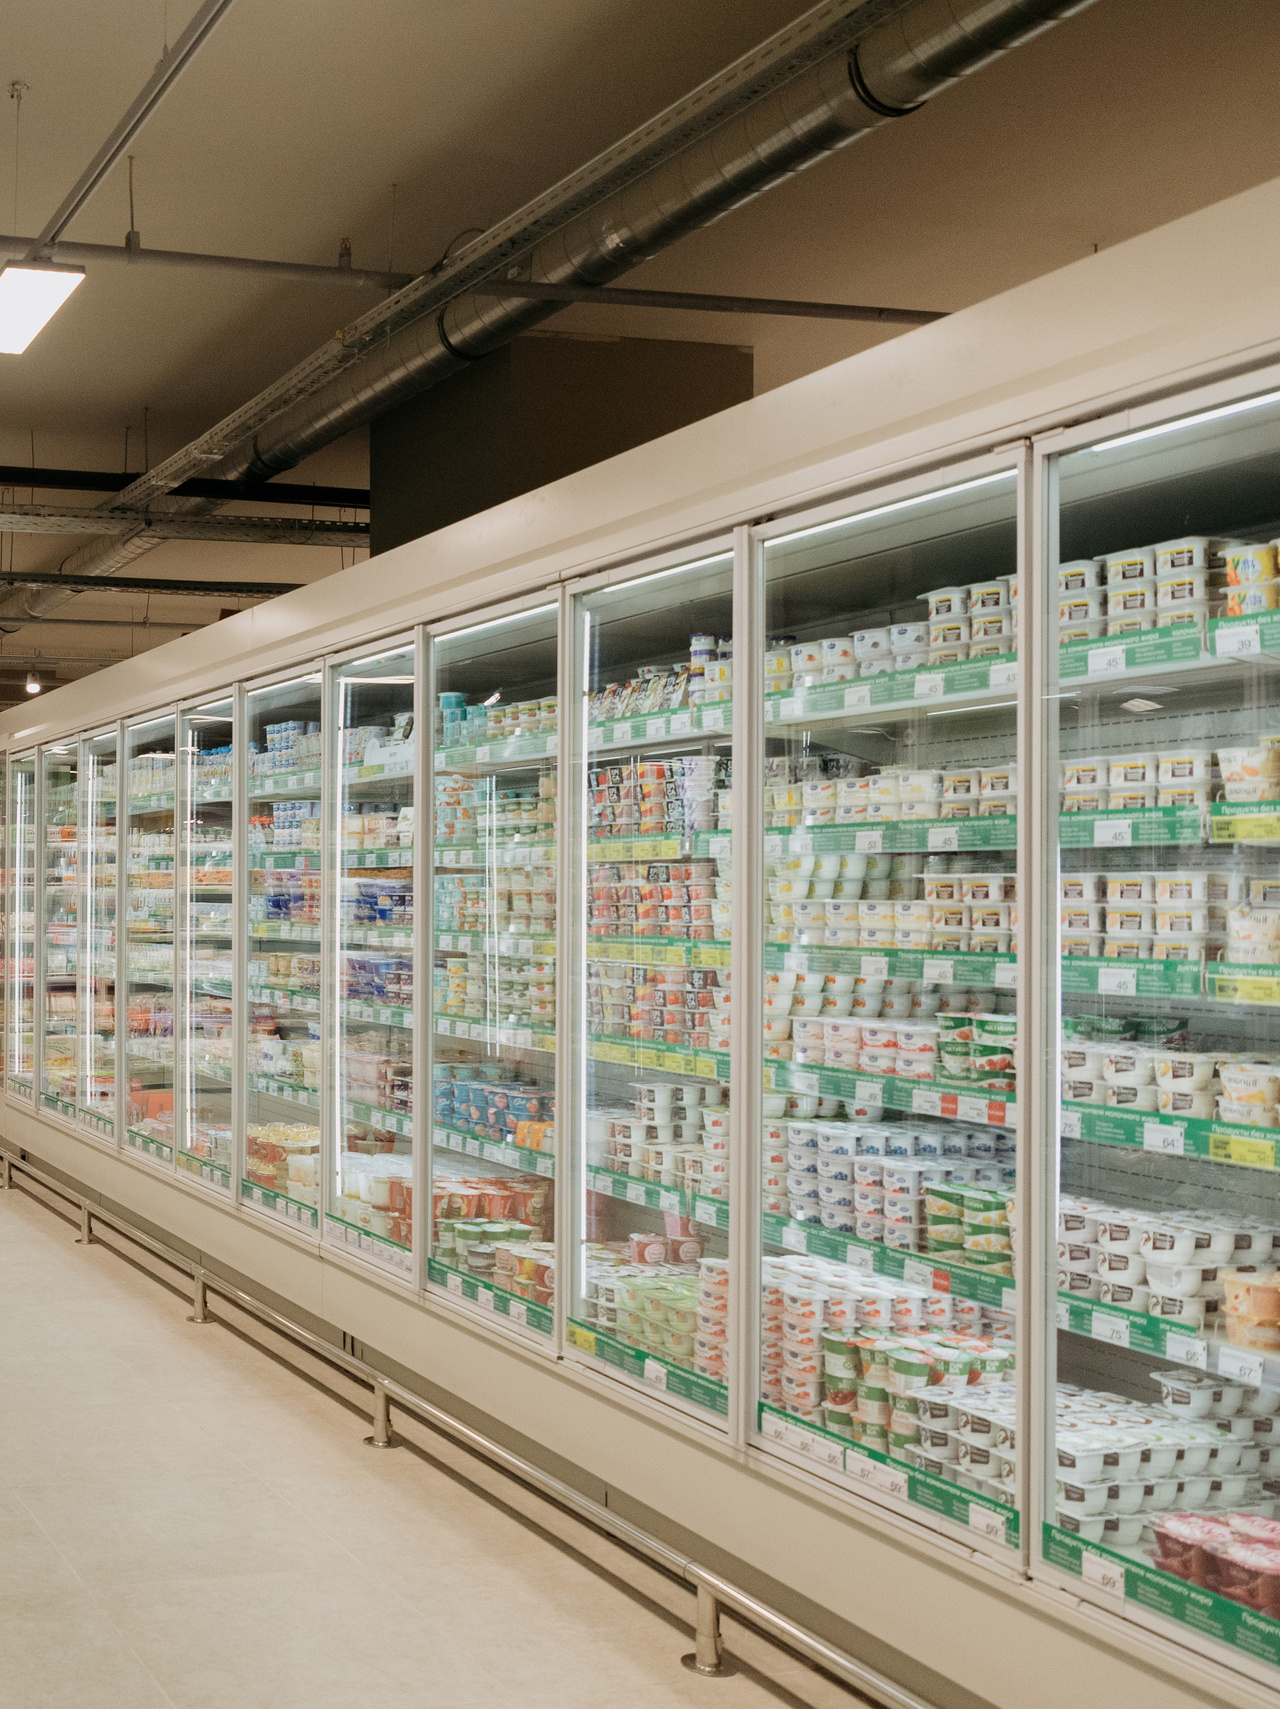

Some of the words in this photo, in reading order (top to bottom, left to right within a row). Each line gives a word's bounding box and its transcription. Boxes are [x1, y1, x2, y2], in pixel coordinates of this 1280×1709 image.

[1106, 657, 1119, 668] 45
[1259, 803, 1274, 812] без
[1117, 981, 1129, 991] 45
[1250, 1129, 1264, 1140] без
[1163, 1137, 1176, 1147] 64
[1190, 1590, 1212, 1607] жира
